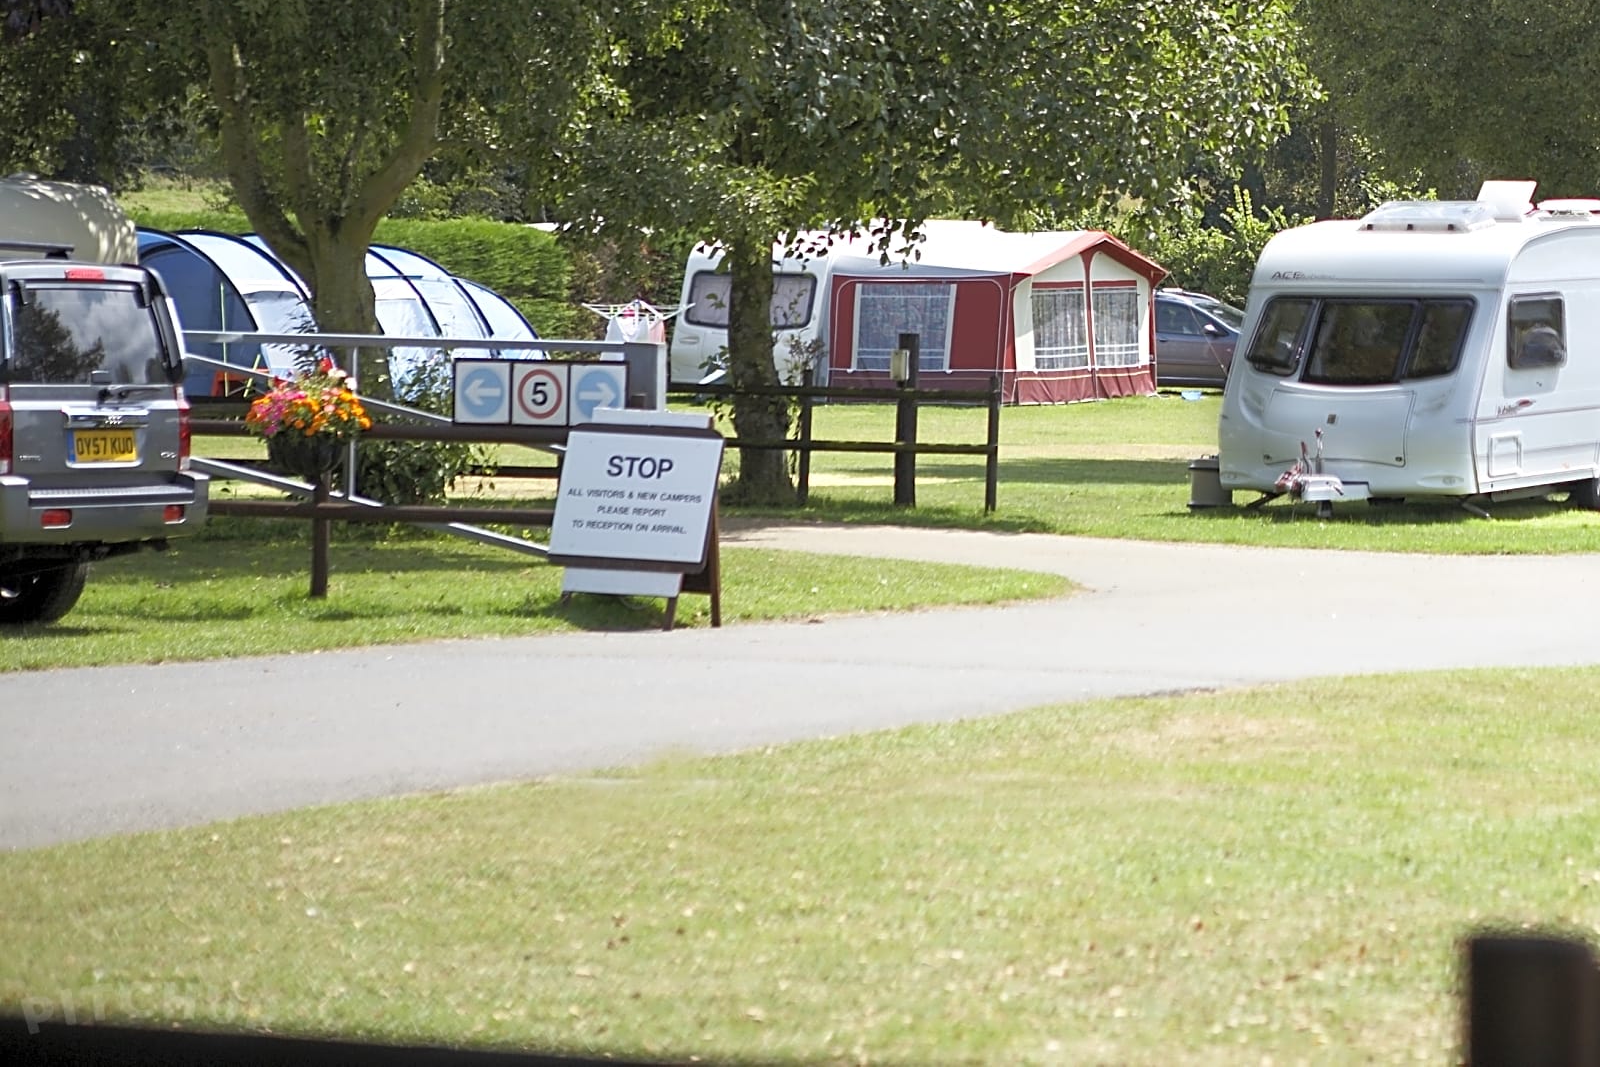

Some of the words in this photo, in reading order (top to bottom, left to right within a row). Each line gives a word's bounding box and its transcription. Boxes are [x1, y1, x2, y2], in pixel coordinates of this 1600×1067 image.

[531, 382, 548, 406] 5
[607, 455, 673, 480] STOP
[568, 489, 583, 497] ALL
[587, 489, 625, 499] VISITORS
[638, 492, 657, 501] NEW
[660, 493, 701, 503] CAMPERS
[597, 506, 628, 515] PLEASE
[632, 508, 666, 517] REPORT
[572, 520, 584, 528] TO
[587, 520, 632, 531] RECEPTION
[636, 523, 648, 531] ON
[652, 524, 687, 534] ARRIVAL.
